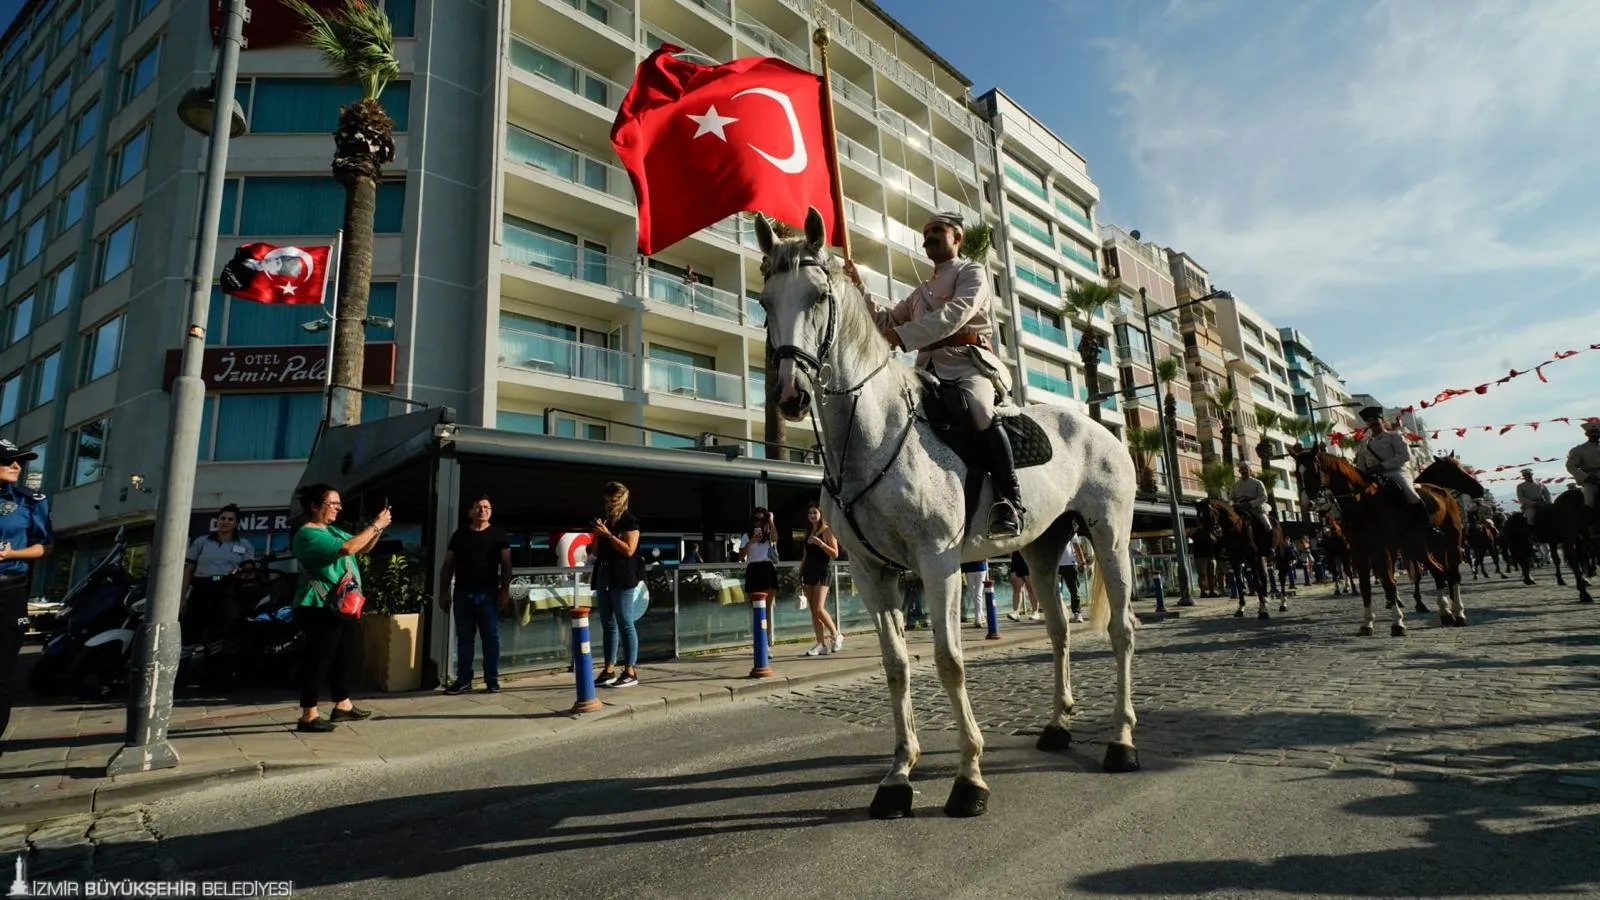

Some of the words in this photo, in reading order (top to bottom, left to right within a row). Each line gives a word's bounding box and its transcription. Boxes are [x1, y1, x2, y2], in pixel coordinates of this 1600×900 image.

[213, 351, 278, 382] İzmir
[279, 354, 329, 383] Pala
[244, 354, 280, 365] OTEL
[209, 513, 269, 532] DNİZ
